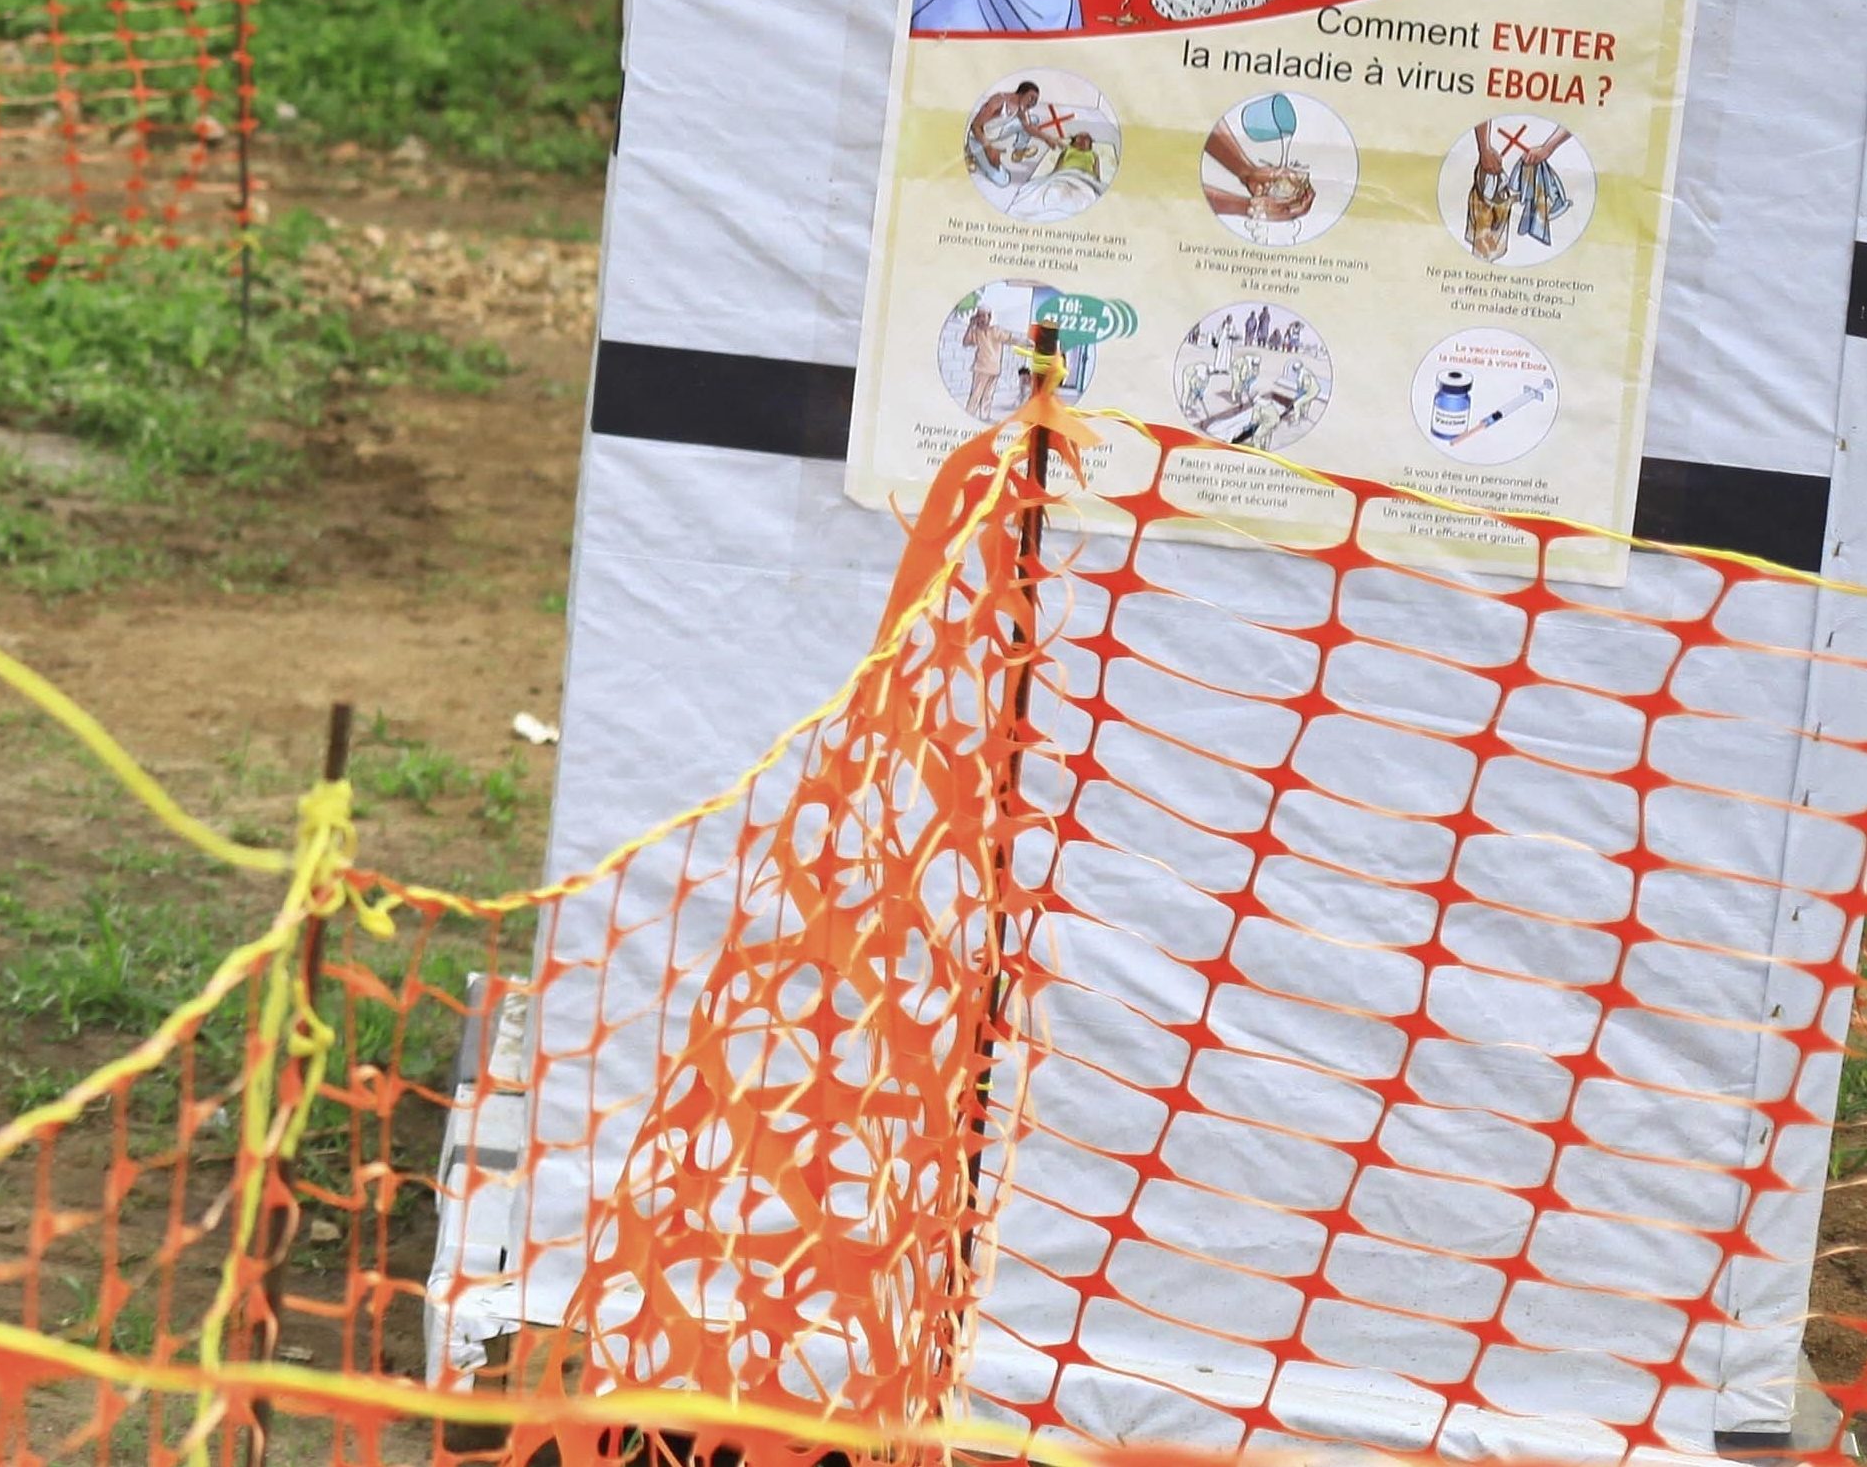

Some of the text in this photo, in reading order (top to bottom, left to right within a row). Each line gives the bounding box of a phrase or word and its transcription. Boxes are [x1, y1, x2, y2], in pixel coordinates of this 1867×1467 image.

[1317, 6, 1616, 62] Comment EVITER
[1183, 39, 1613, 107] la maladie à virus EBOLA ?
[948, 218, 1127, 246] Ne pas toucher ni manipuler sans
[938, 233, 1133, 261] protection une personne malade ou
[1179, 242, 1369, 270] Lavez-vous fréquemment les mains
[989, 254, 1079, 271] décédée d'Ebola
[1196, 259, 1349, 284] à l'eau propre et au savon ou
[1241, 279, 1300, 295] à la cendre
[1426, 266, 1594, 293] Ne pas toucher sans protection
[1441, 283, 1456, 294] les
[1458, 284, 1488, 297] effets
[1490, 287, 1530, 302] (habits,
[1059, 298, 1082, 314] Tél:
[1451, 300, 1561, 319] d'un malade d'Ebola
[1060, 314, 1077, 331] 22
[1079, 317, 1097, 333] 22
[1469, 346, 1499, 355] vaccin
[1501, 349, 1530, 358] contre
[1439, 354, 1448, 362] la
[1449, 354, 1484, 366] maladie
[1495, 360, 1518, 369] virus
[1521, 361, 1547, 371] Ebola
[914, 423, 958, 438] Appelez
[917, 440, 937, 450] afin
[1093, 459, 1107, 468] ou
[1048, 469, 1094, 481] de saté
[1180, 457, 1299, 478] Faites appel aux serv
[1403, 466, 1548, 489] Si vous êtes un personnel de
[1221, 479, 1247, 488] pour
[1250, 480, 1264, 489] un
[1267, 483, 1335, 498] enterrement
[1420, 484, 1432, 493] ou
[1436, 484, 1448, 494] de
[1450, 486, 1508, 501] l'entourage
[1510, 492, 1559, 505] immédiat
[1197, 490, 1288, 508] digne et sécurisé
[1383, 507, 1398, 517] Un
[1401, 510, 1432, 521] vaccin
[1435, 513, 1481, 527] préventif
[1484, 518, 1498, 527] est
[1410, 526, 1418, 534] Il
[1436, 527, 1475, 540] efficace
[1478, 532, 1488, 541] et
[1490, 533, 1526, 545] gratuit.
